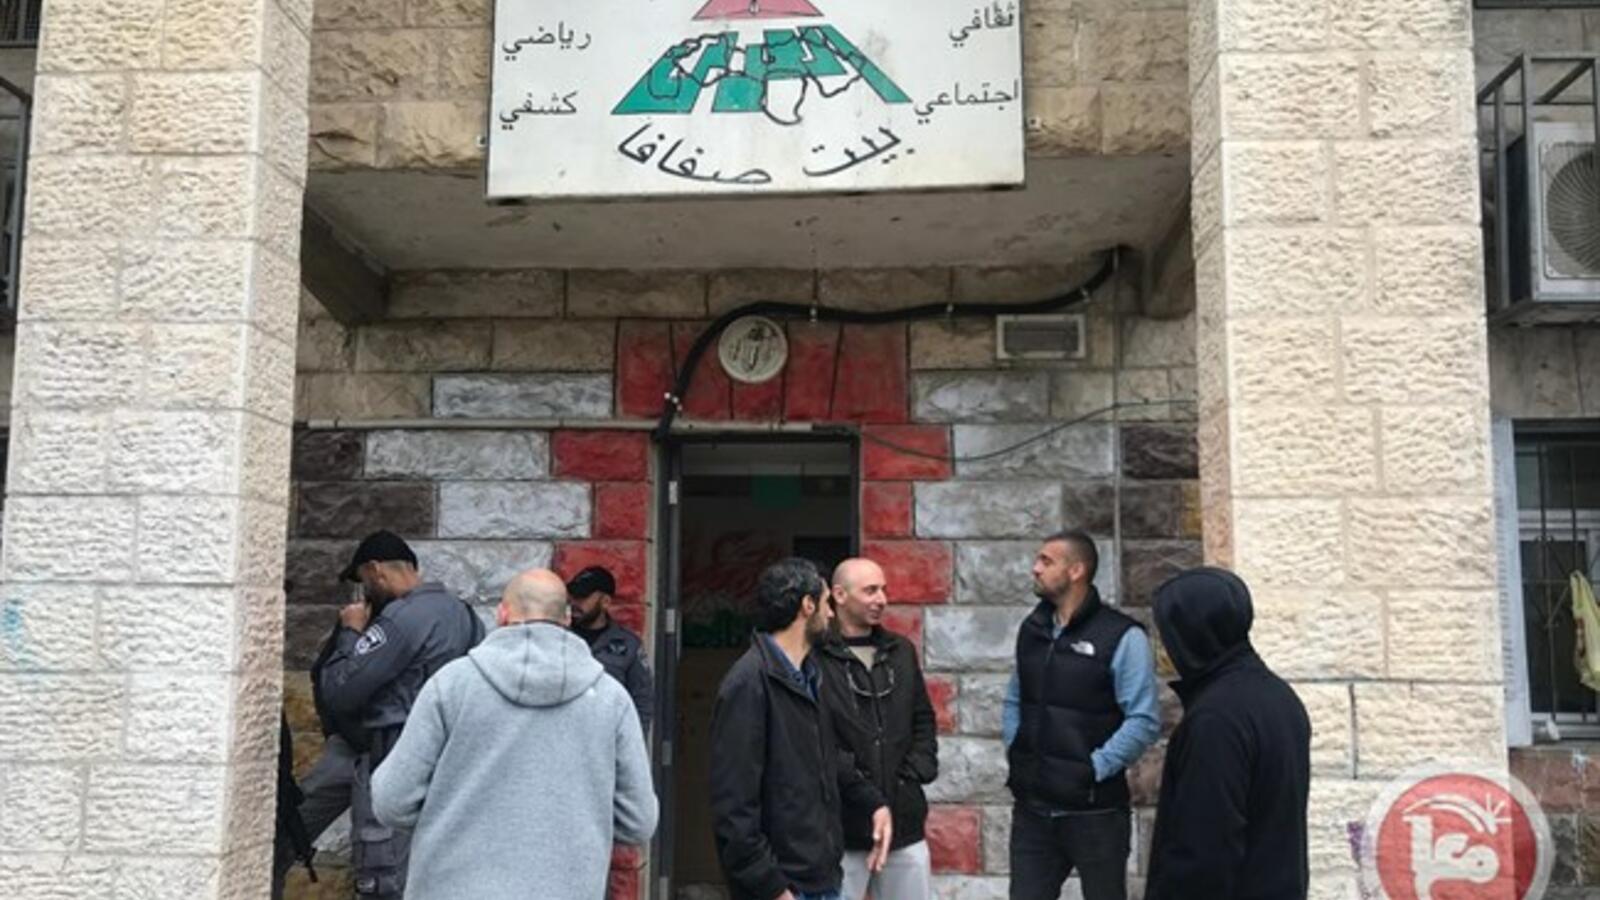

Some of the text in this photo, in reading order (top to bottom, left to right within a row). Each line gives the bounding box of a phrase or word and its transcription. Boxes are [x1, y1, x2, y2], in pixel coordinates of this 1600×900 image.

[501, 21, 592, 61] رياضي
[949, 0, 1015, 47] ثقافي
[499, 90, 578, 130] كشفي
[914, 79, 1019, 124] اجتماعي
[617, 122, 915, 184] بيت صفافا
